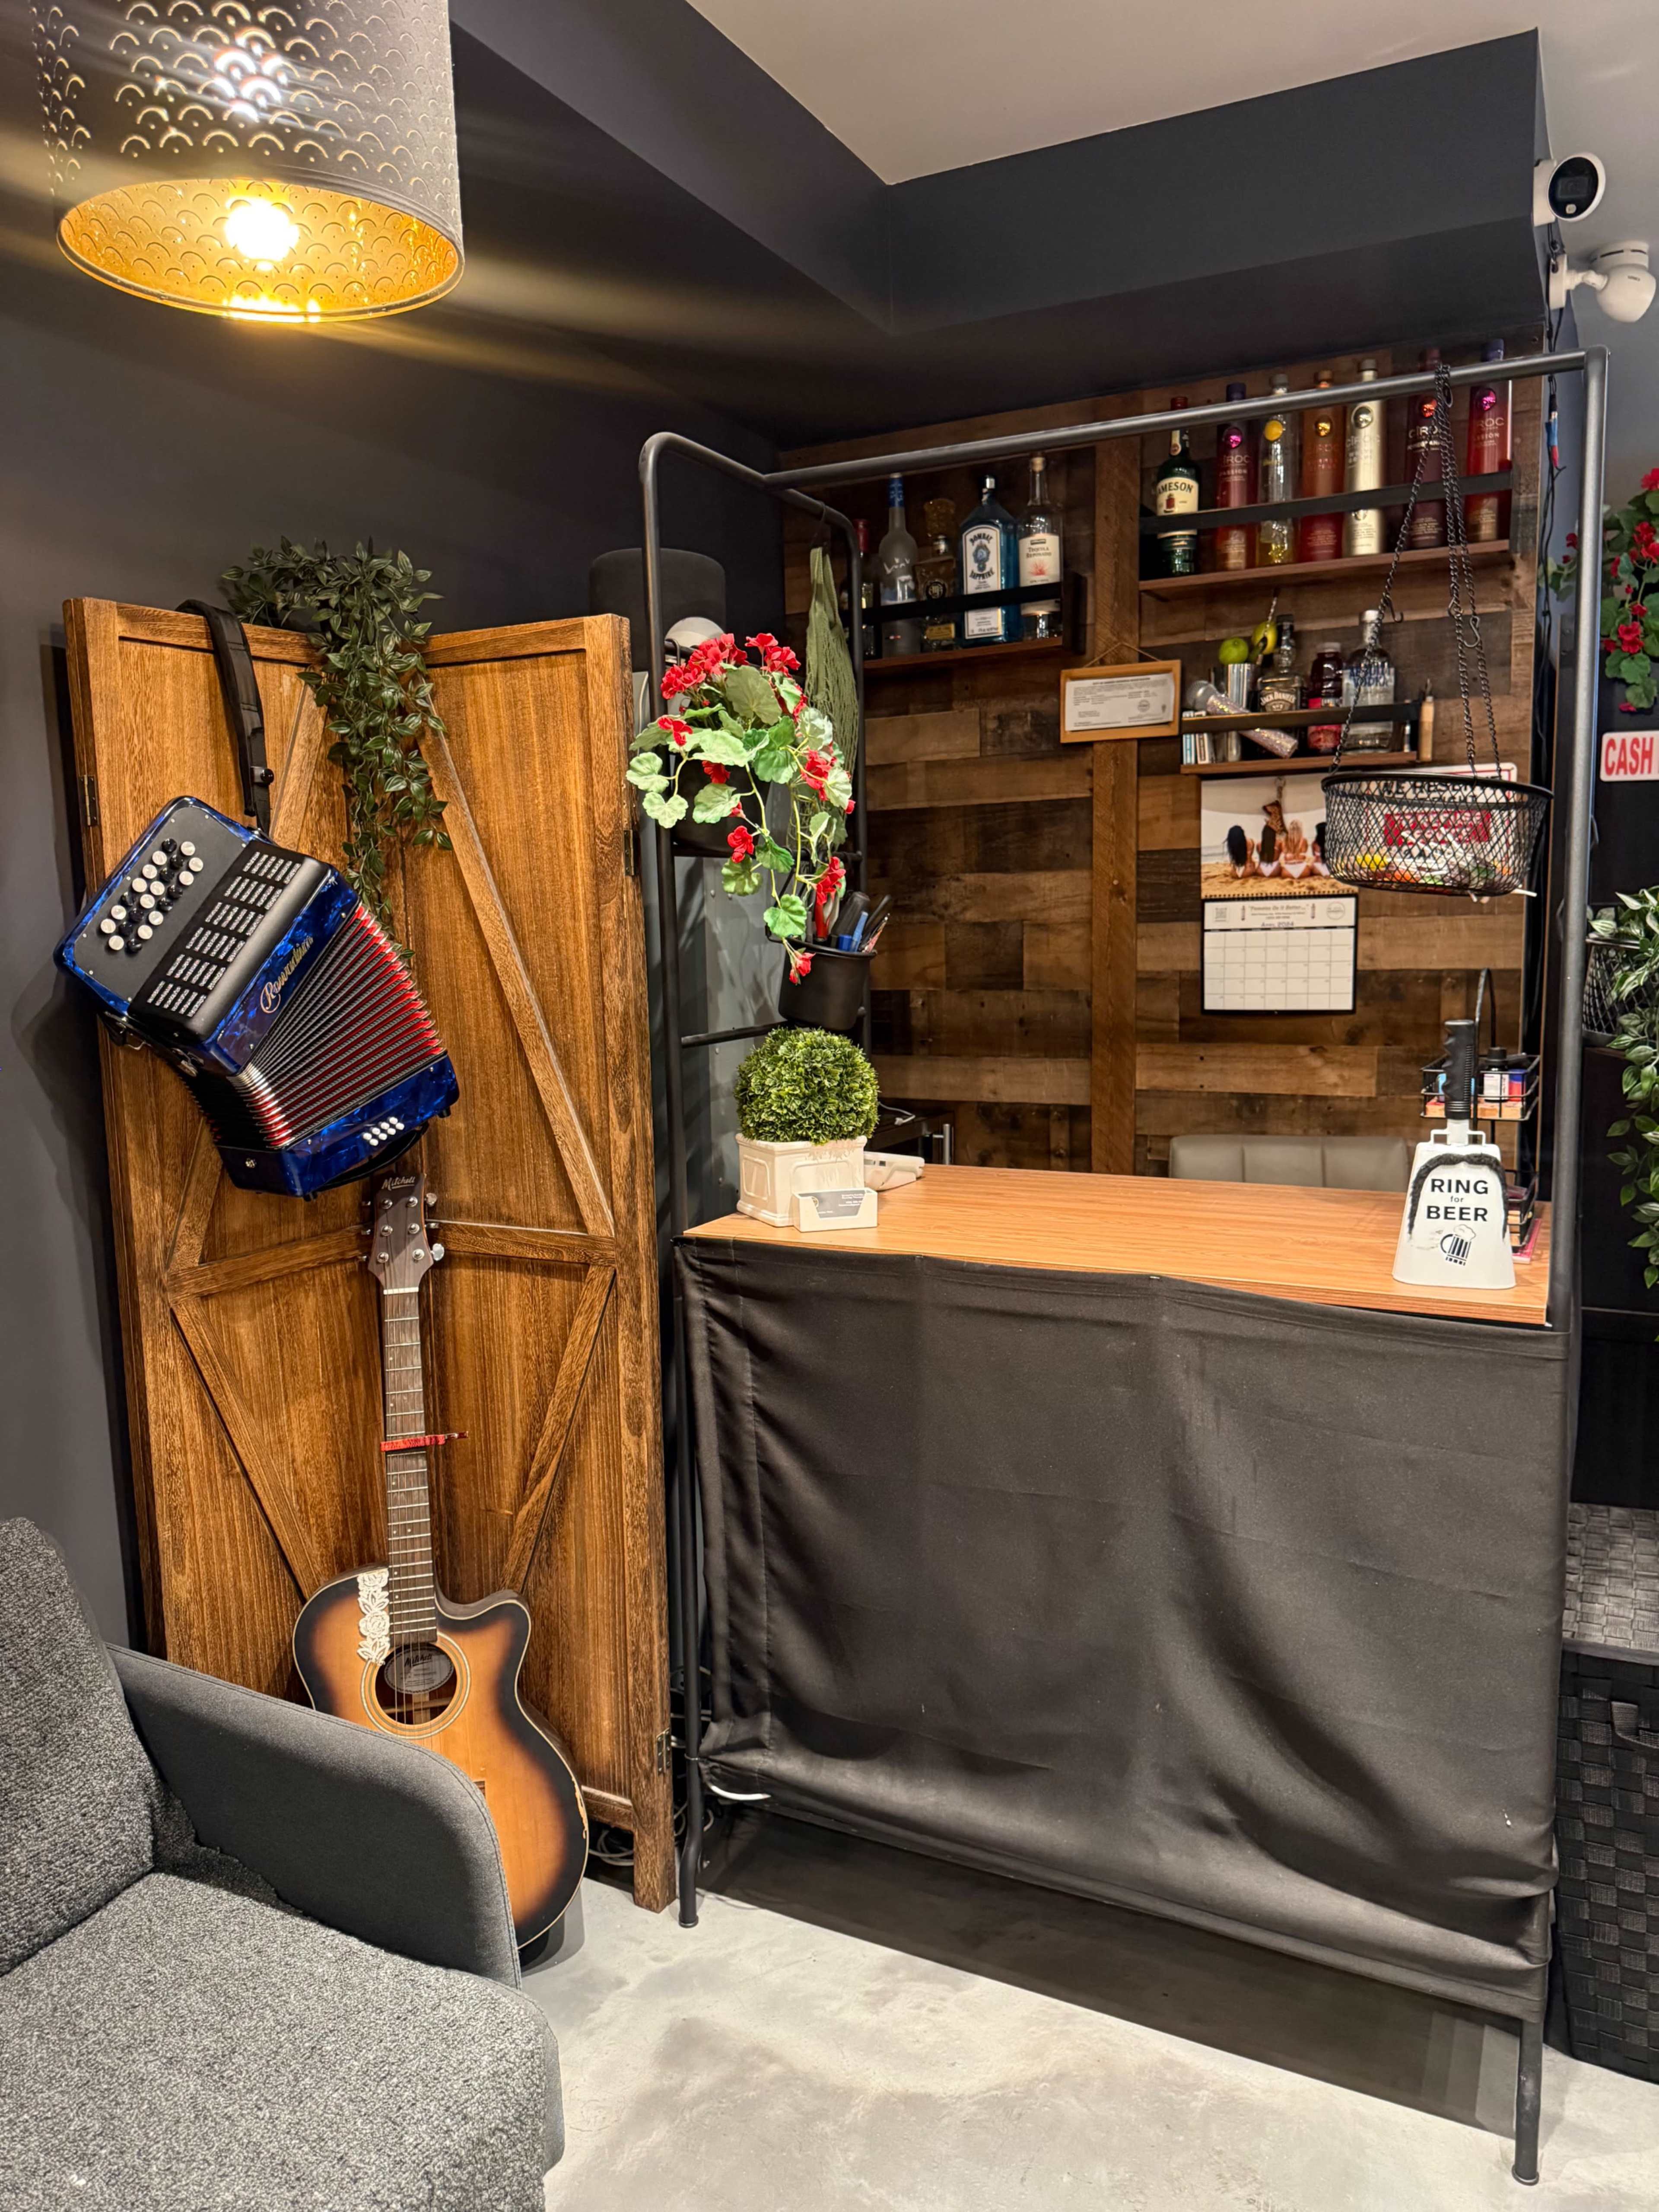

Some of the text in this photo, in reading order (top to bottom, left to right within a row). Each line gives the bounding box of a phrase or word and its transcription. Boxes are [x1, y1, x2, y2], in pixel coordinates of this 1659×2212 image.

[969, 532, 993, 546] BOMBAY
[969, 567, 995, 581] SAPPHIRE
[1605, 737, 1654, 776] CASH
[381, 1176, 415, 1191] Mitchell
[1430, 1178, 1489, 1195] RING
[1450, 1195, 1464, 1204] for
[1426, 1205, 1488, 1222] BEER
